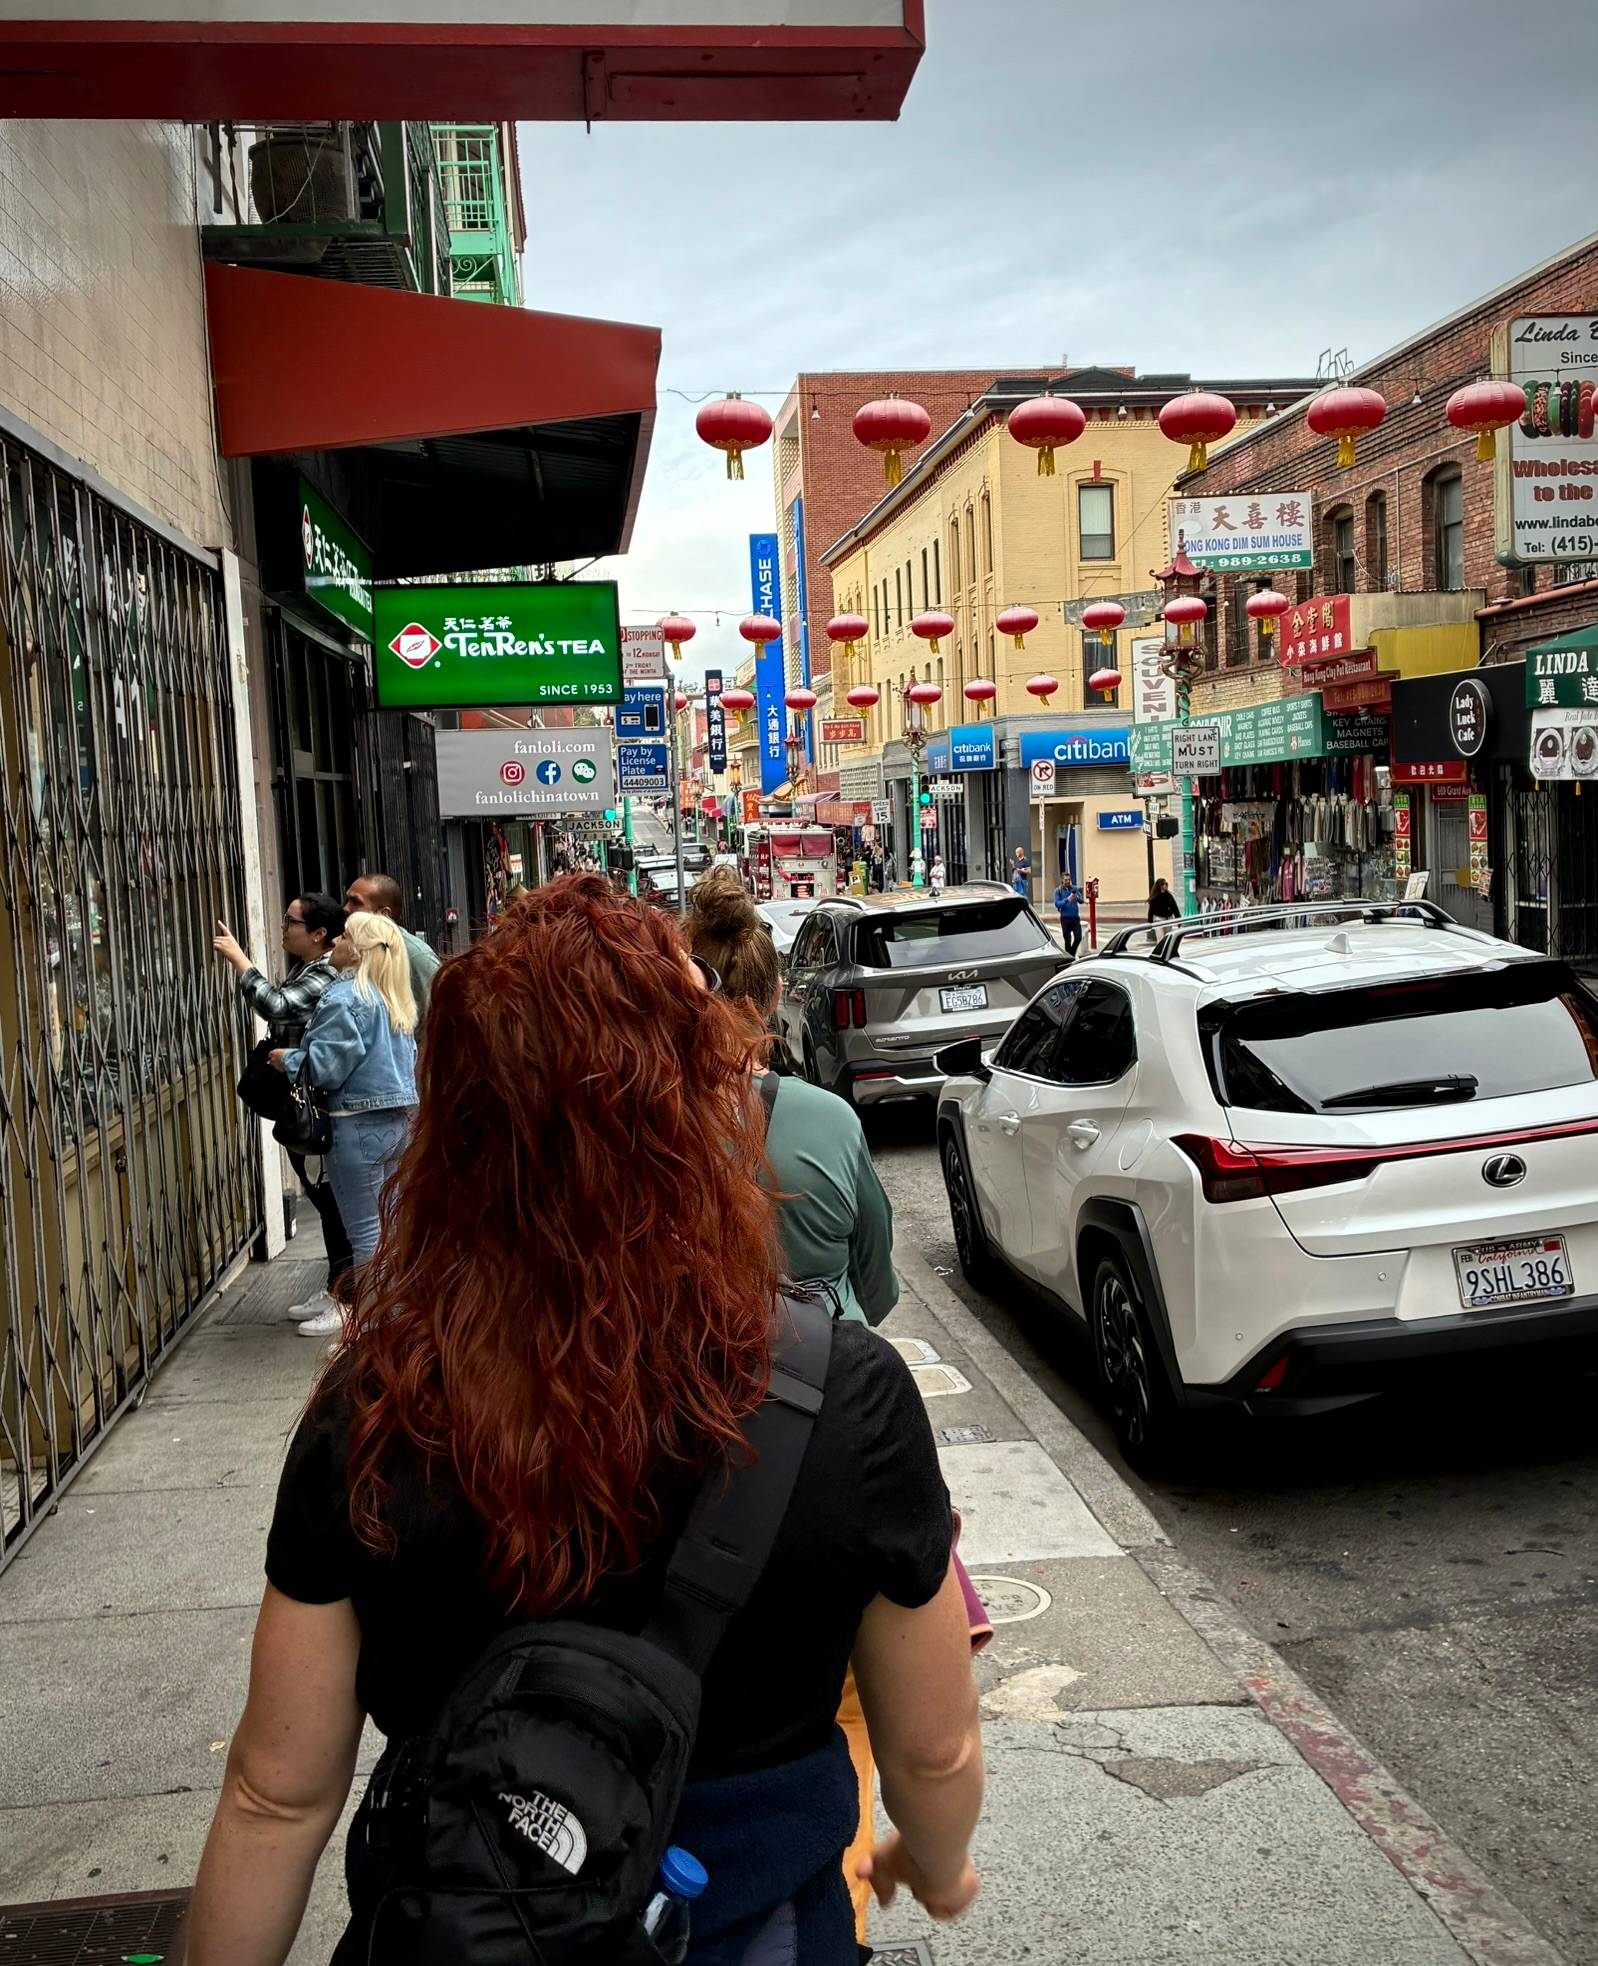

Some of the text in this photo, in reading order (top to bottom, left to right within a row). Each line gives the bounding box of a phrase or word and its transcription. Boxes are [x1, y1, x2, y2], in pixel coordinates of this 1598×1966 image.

[1514, 321, 1580, 342] Linda
[1534, 483, 1593, 501] to the
[1176, 501, 1201, 515] 香港
[1211, 500, 1304, 531] 天喜樓
[1183, 534, 1302, 552] ONG KONG DIM SUM HOUSE
[1524, 542, 1545, 553] Tel:
[1218, 553, 1302, 567] 989-2638
[627, 630, 663, 641] STOPPING
[556, 640, 605, 654] TEA
[633, 648, 642, 658] 12
[1326, 666, 1336, 680] Clay
[1345, 660, 1371, 675] Restaurant
[1534, 651, 1589, 676] LINDA
[540, 684, 612, 695] SINCE 1953
[624, 692, 661, 704] ay here
[1455, 694, 1474, 710] Lady
[1332, 718, 1350, 727] KEY
[1456, 710, 1476, 725] Luck
[767, 704, 780, 758] 大通銀行
[1337, 728, 1383, 738] MAGNETS
[1458, 727, 1474, 742] Cafe
[1174, 733, 1217, 743] RIGHT LANE
[1326, 739, 1369, 750] BASEBALL
[514, 740, 596, 754] fanloli.com
[621, 746, 653, 758] Pay by
[953, 743, 991, 754] citibank
[1178, 746, 1214, 757] MUST
[621, 757, 656, 765] License
[1175, 760, 1218, 770] TURN RIGHT
[621, 766, 646, 775] Plate
[623, 777, 664, 786] 44409003
[475, 790, 599, 804] fanlolichinatown
[876, 812, 888, 822] 15
[1111, 814, 1132, 824] ATM
[569, 820, 620, 831] JACKSON
[1466, 1256, 1565, 1297] 9SHL386
[533, 1790, 568, 1822] THE
[498, 1792, 561, 1837] NORTH
[508, 1807, 554, 1851] FACE
